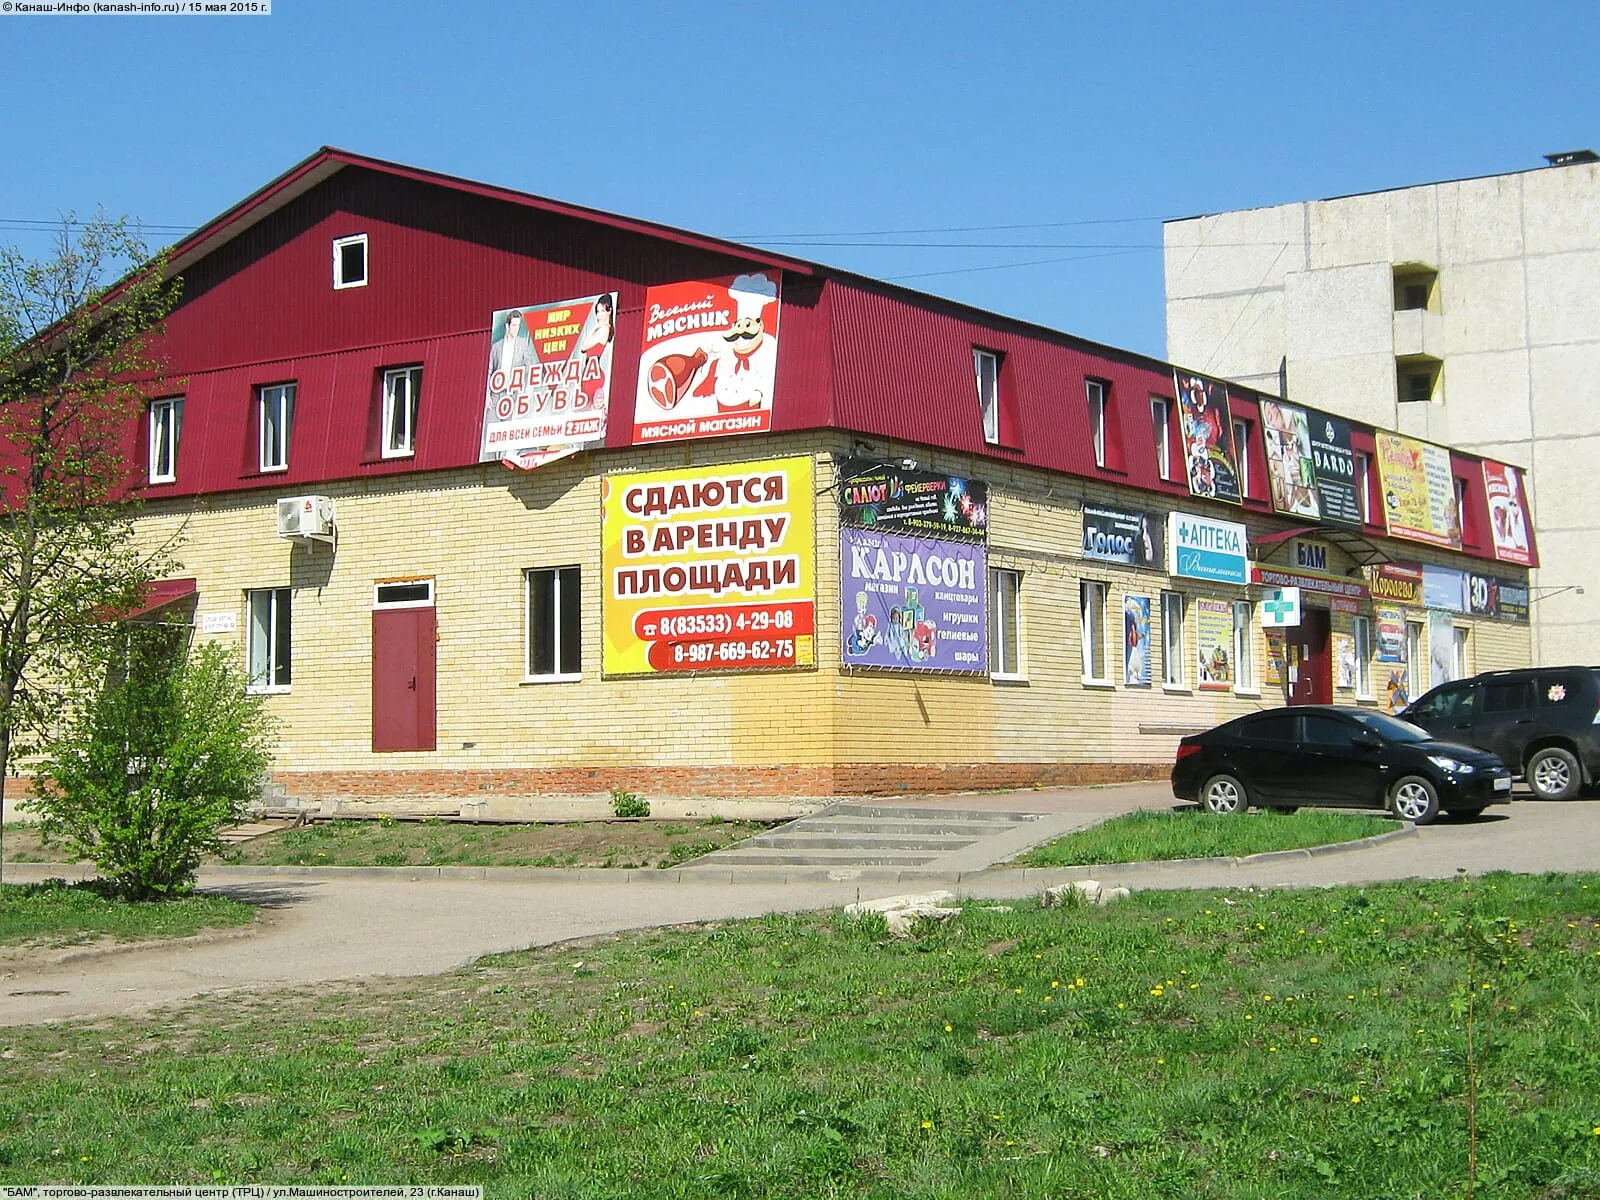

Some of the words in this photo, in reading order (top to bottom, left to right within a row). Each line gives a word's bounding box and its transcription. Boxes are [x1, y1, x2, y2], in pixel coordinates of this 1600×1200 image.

[547, 309, 571, 324] МИР
[649, 295, 715, 324] Веселый
[534, 324, 580, 341] НИЗКИХ
[543, 339, 567, 355] ЦЕН
[491, 356, 601, 392] ОДЕЖДА
[498, 391, 590, 419] ОБУВЬ
[488, 431, 507, 443] ДЛЯ
[508, 428, 531, 440] ВСЕЙ
[532, 424, 563, 438] СЕМЬИ
[1313, 451, 1354, 476] BARDO
[625, 475, 784, 516] СДАЮТСЯ
[844, 481, 887, 505] САЛЮТ
[626, 529, 646, 554] В
[652, 517, 786, 552] АРЕНДУ
[1190, 522, 1241, 552] АПТЕКА
[851, 545, 976, 590] КАРЛСОН
[1297, 542, 1327, 570] БАМ
[617, 558, 796, 595] ПЛОЩАДИ
[864, 582, 899, 595] магазин
[1372, 570, 1413, 599] Королева
[659, 613, 732, 637] 8(83533)
[736, 610, 793, 631] 4-29-08
[943, 612, 979, 625] игрушки
[937, 629, 979, 642] гелиевые
[674, 640, 794, 663] 8-987-669-62-75
[954, 651, 979, 664] шары
